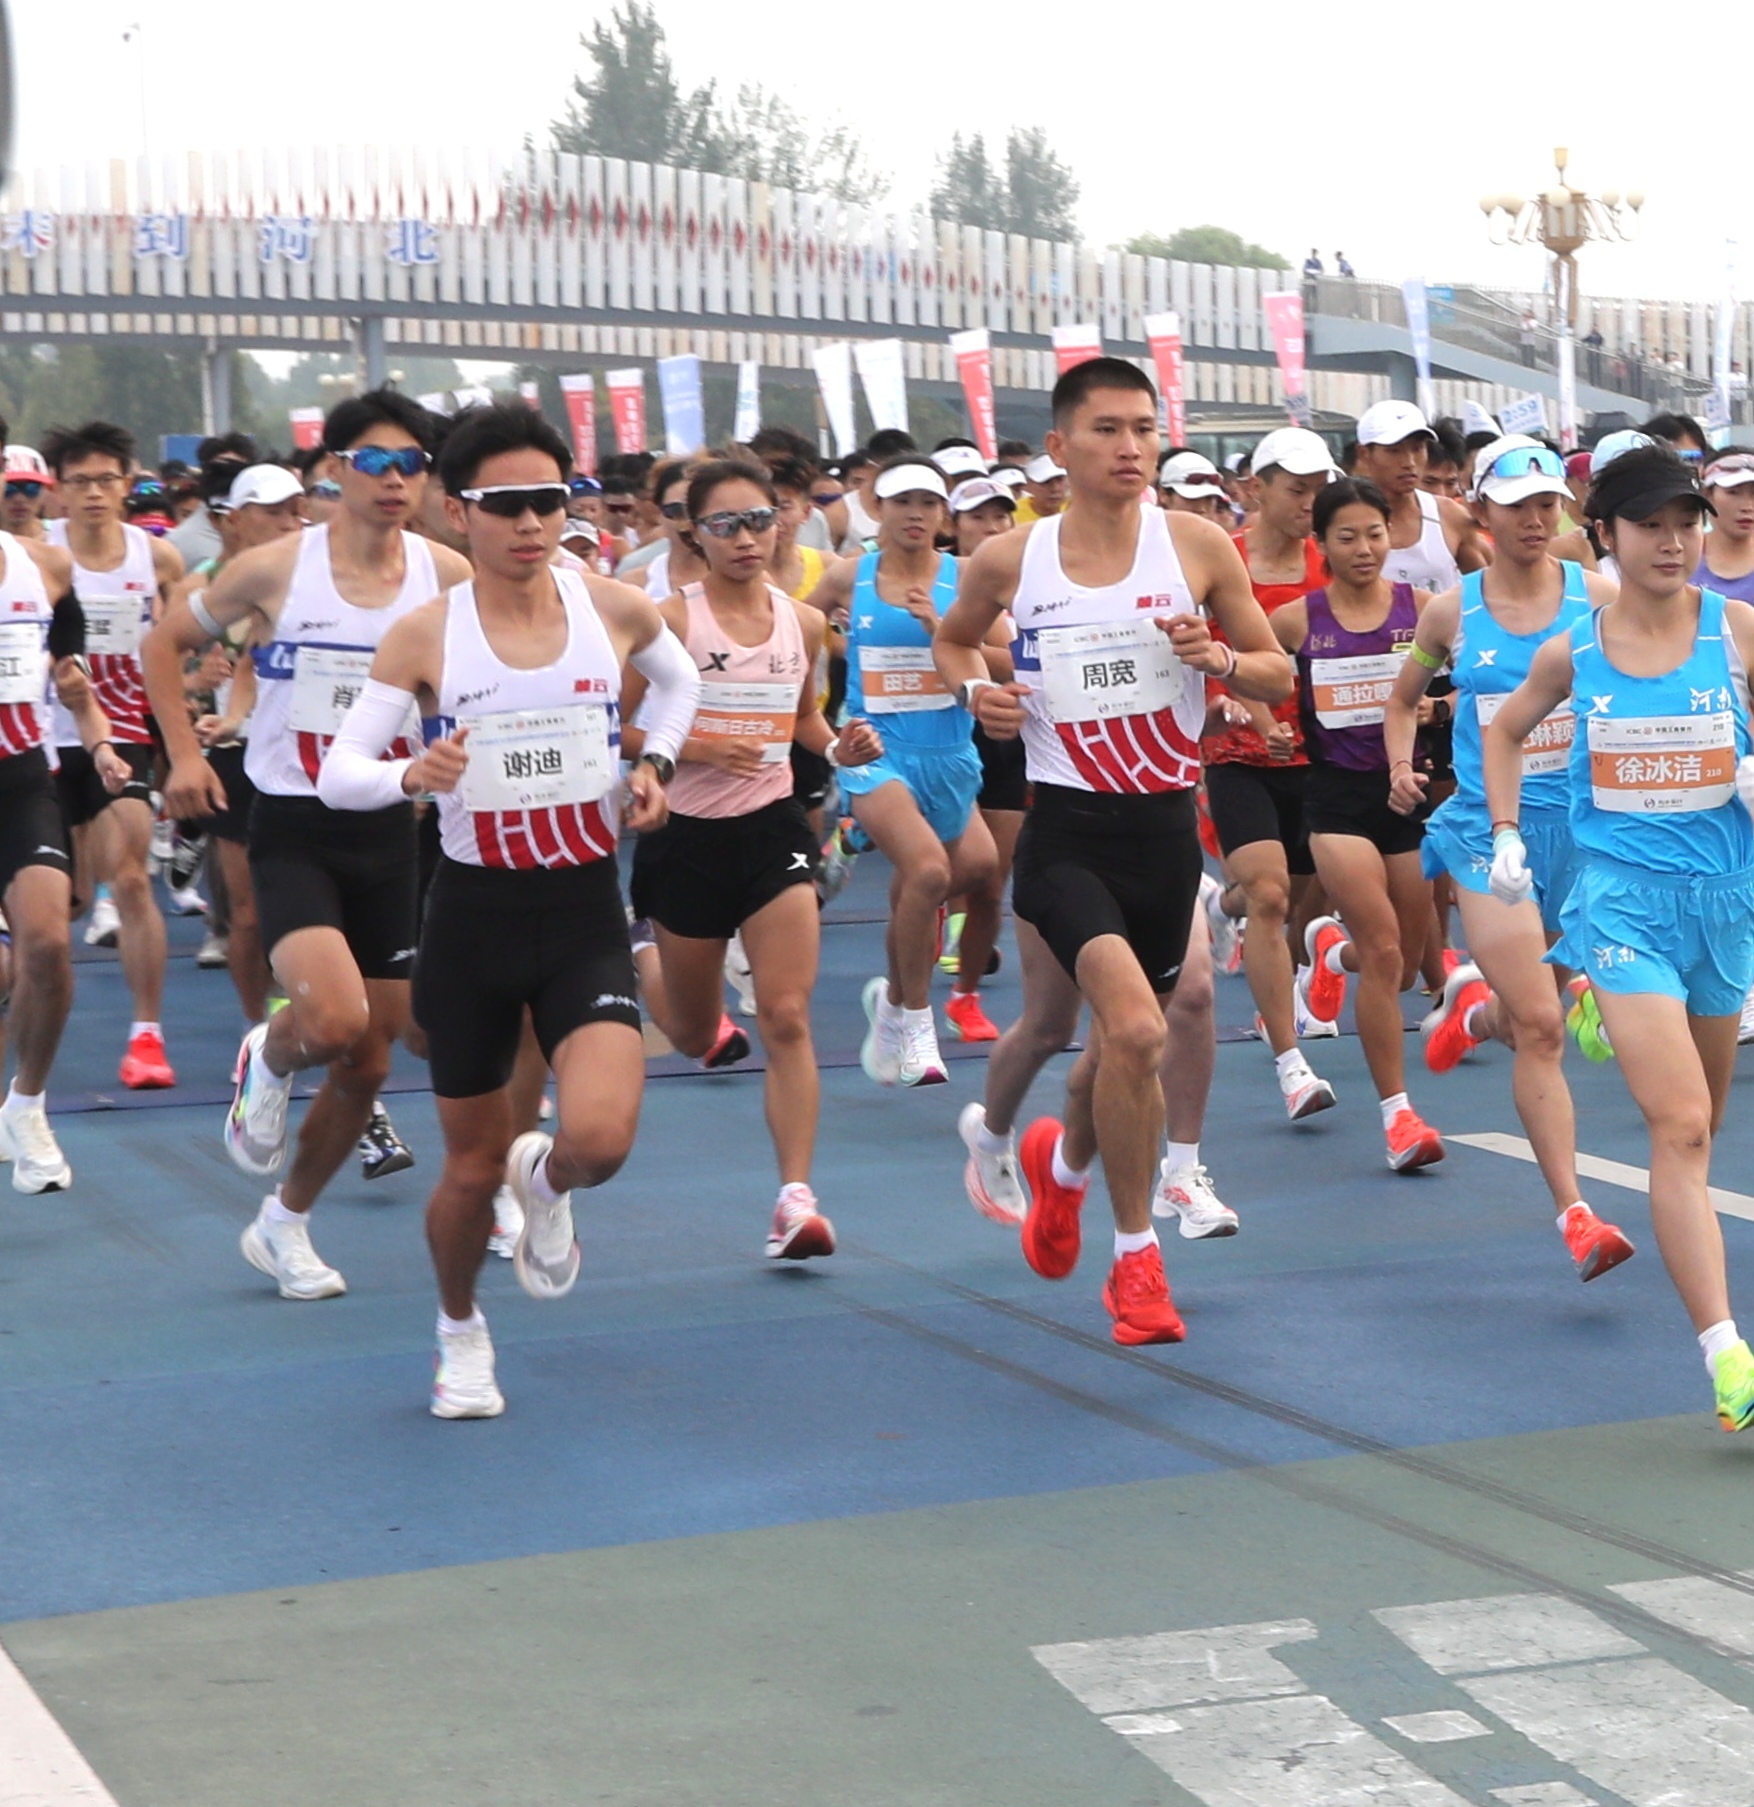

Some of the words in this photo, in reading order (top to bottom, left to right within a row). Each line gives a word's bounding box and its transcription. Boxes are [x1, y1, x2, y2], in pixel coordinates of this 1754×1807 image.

[1082, 659, 1137, 690] 周宽
[503, 747, 563, 779] 谢迪
[1615, 754, 1702, 783] 徐冰洁
[1706, 768, 1722, 777] 210
[1592, 945, 1636, 970] 河南
